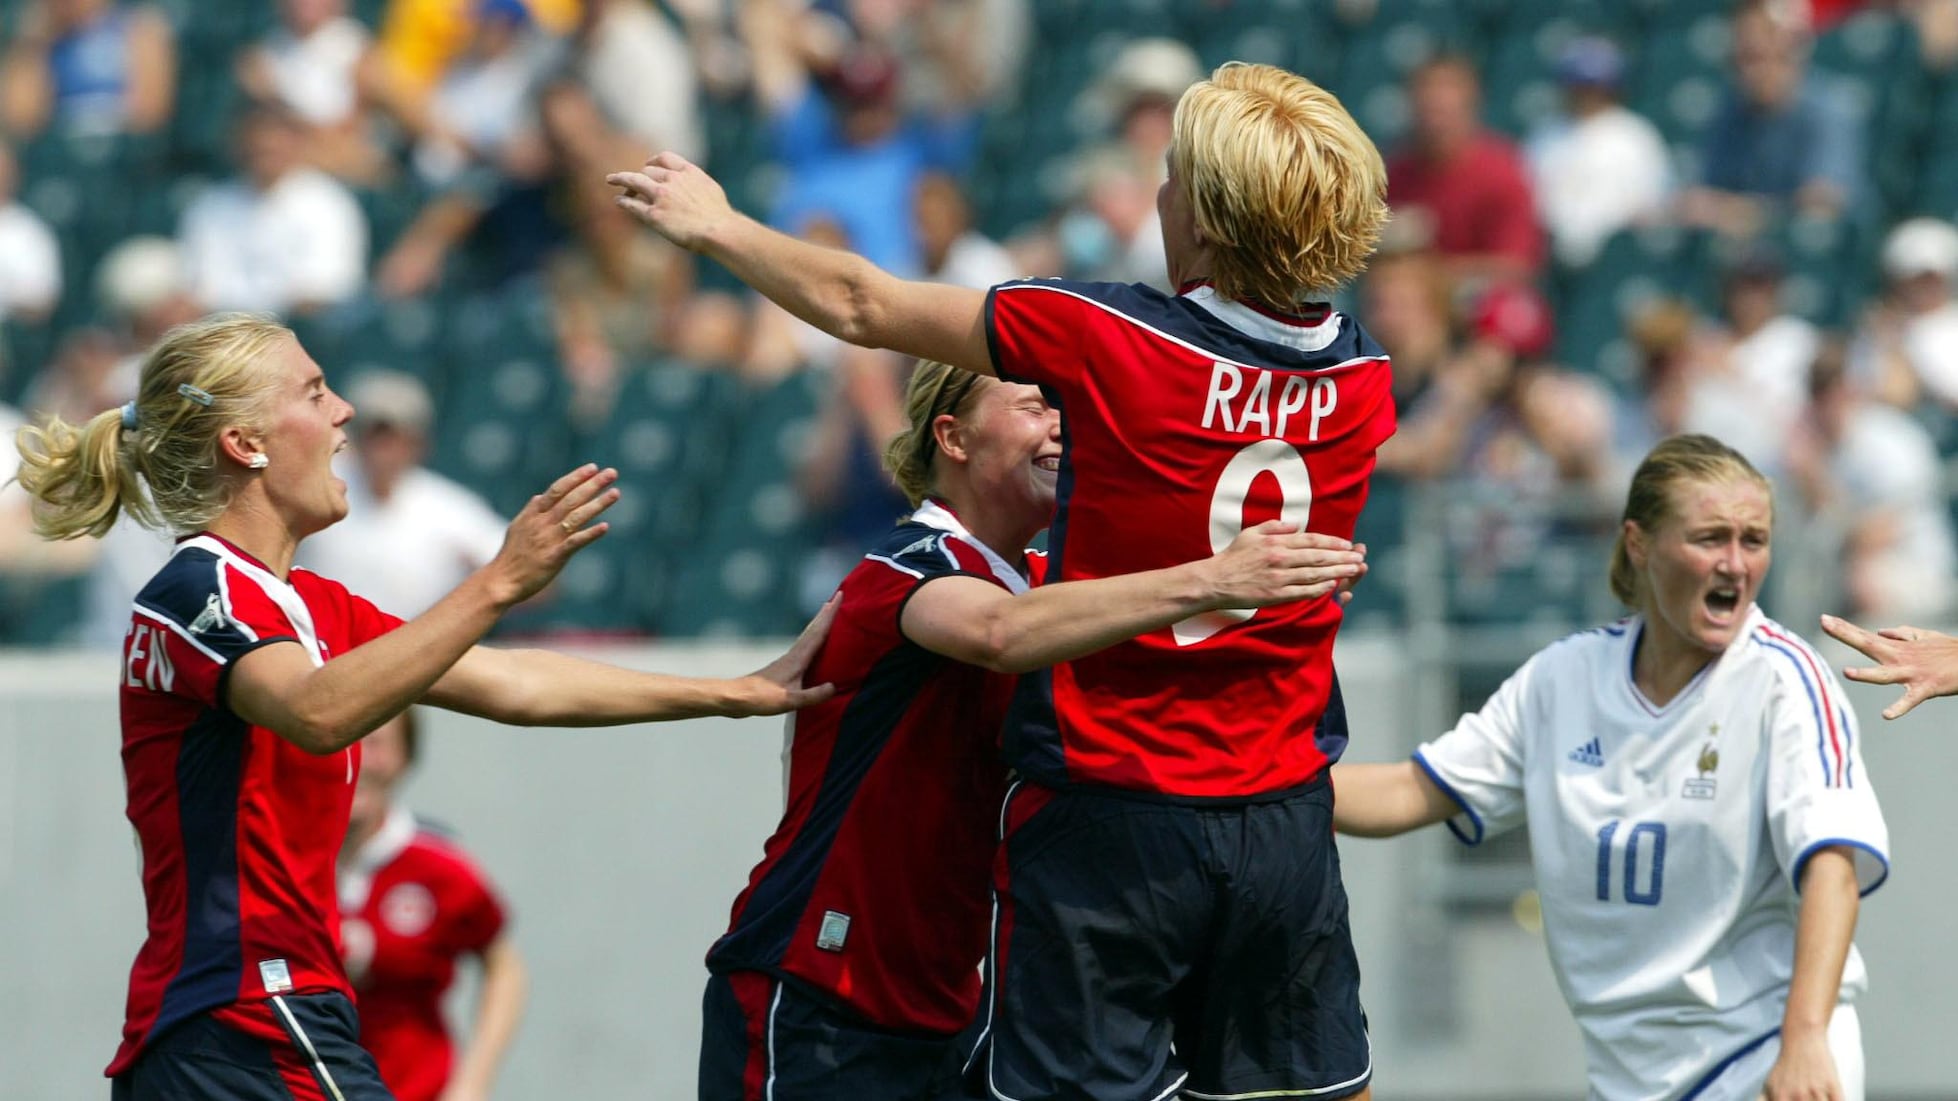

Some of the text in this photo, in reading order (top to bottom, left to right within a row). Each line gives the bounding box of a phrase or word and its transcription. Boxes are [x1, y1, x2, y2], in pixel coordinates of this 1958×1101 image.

[1201, 361, 1338, 441] RAPP
[1172, 439, 1312, 646] 9
[121, 624, 175, 692] EN
[1597, 820, 1667, 905] 10
